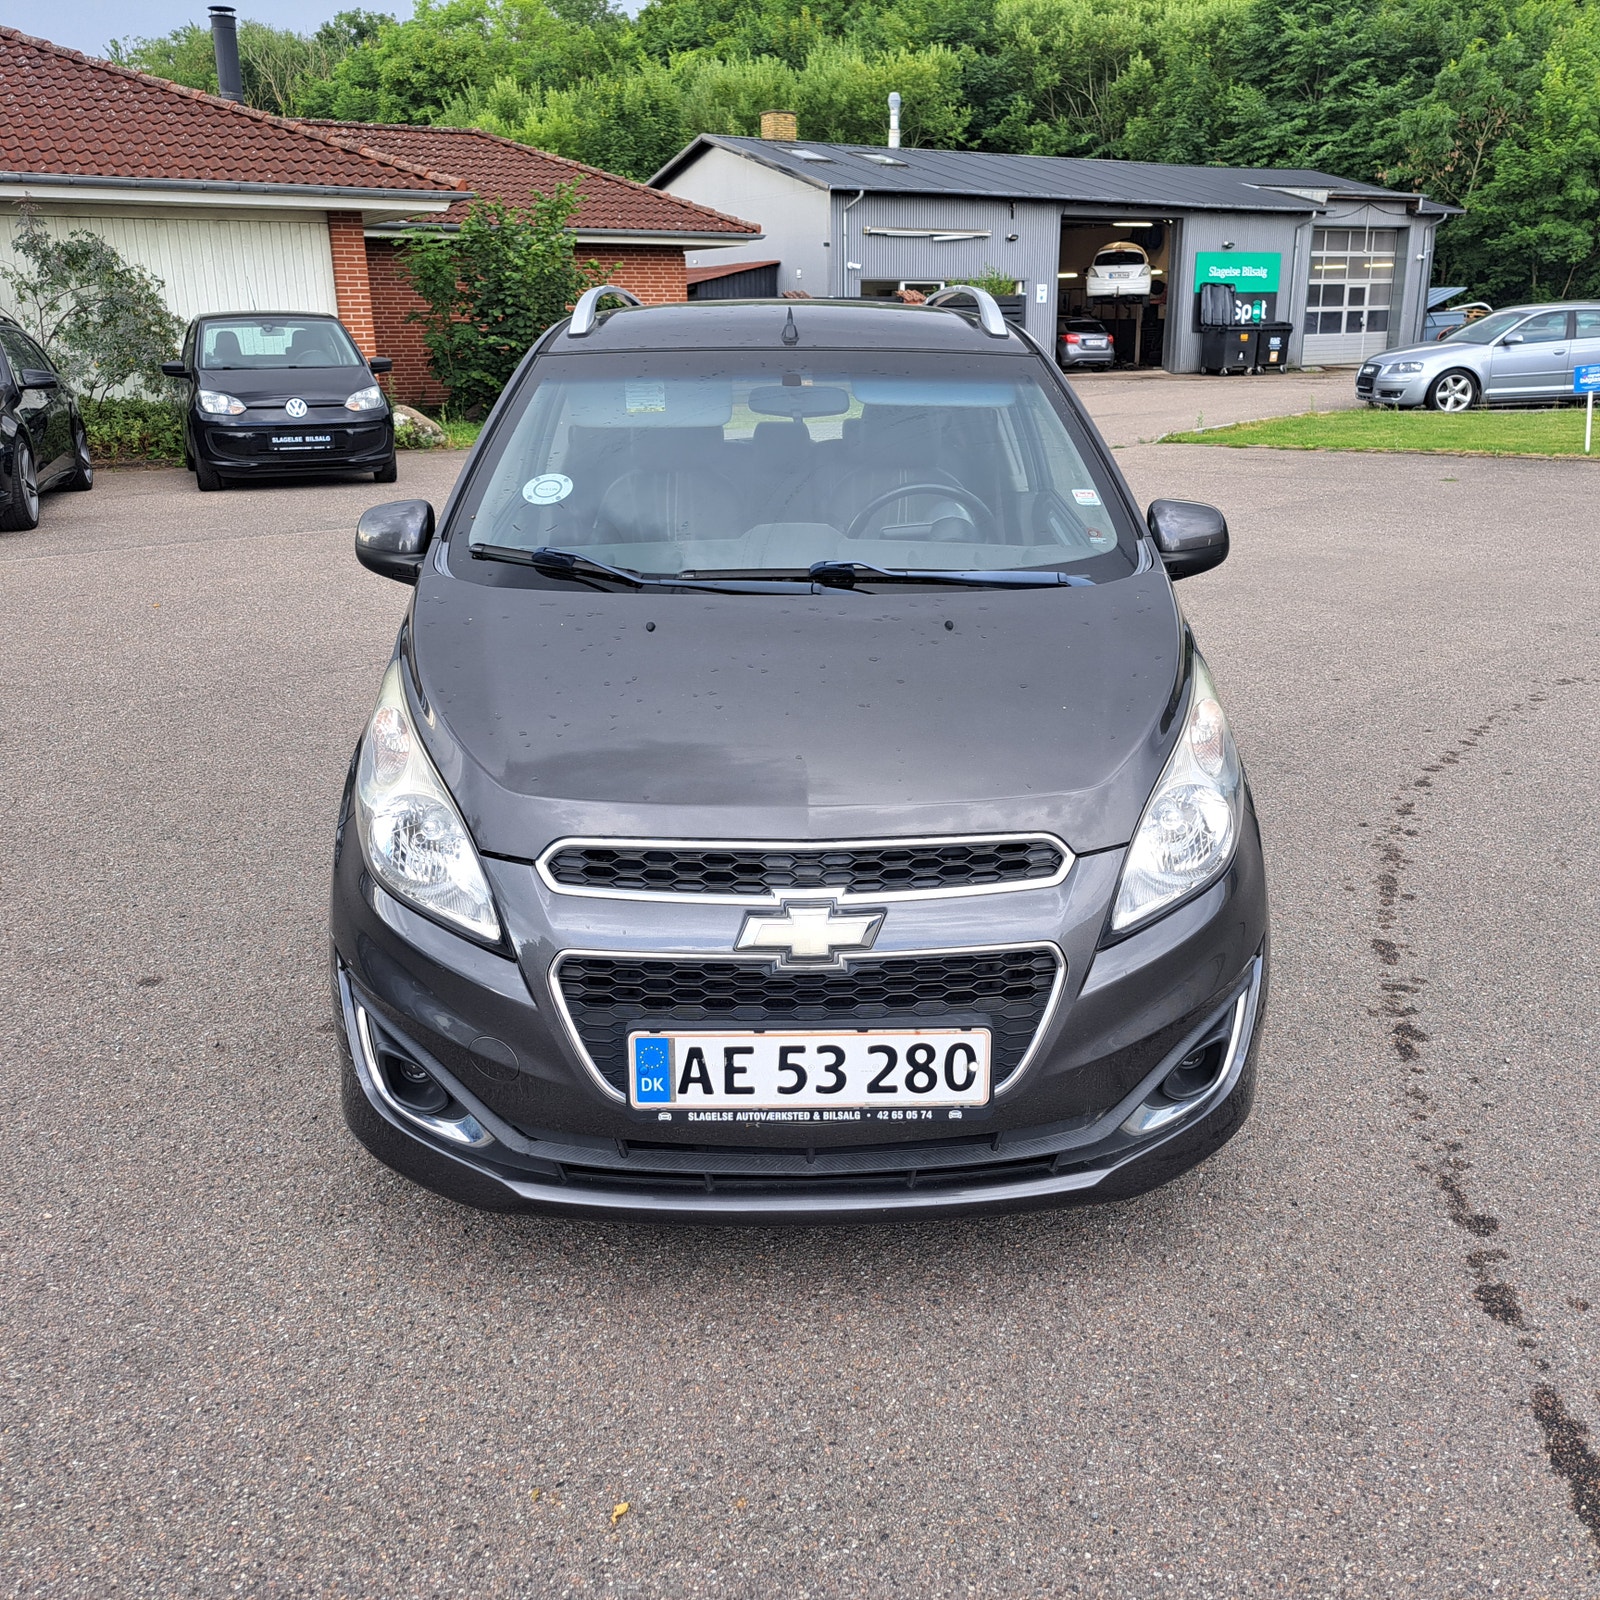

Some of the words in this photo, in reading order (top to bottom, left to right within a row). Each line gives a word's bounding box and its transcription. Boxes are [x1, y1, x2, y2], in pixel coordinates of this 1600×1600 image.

[1242, 266, 1267, 278] Bilsalg
[677, 1046, 756, 1095] AE
[776, 1045, 848, 1095] 53
[866, 1042, 978, 1094] 280
[641, 1077, 664, 1092] DK
[687, 1111, 734, 1121] SLAGELSE
[736, 1111, 811, 1121] AUTOVÆRKSTED
[812, 1111, 821, 1121] &
[822, 1111, 861, 1120] BILSALG
[876, 1110, 889, 1120] 42
[891, 1110, 904, 1120] 65
[905, 1110, 918, 1120] 05
[920, 1110, 933, 1120] 74
